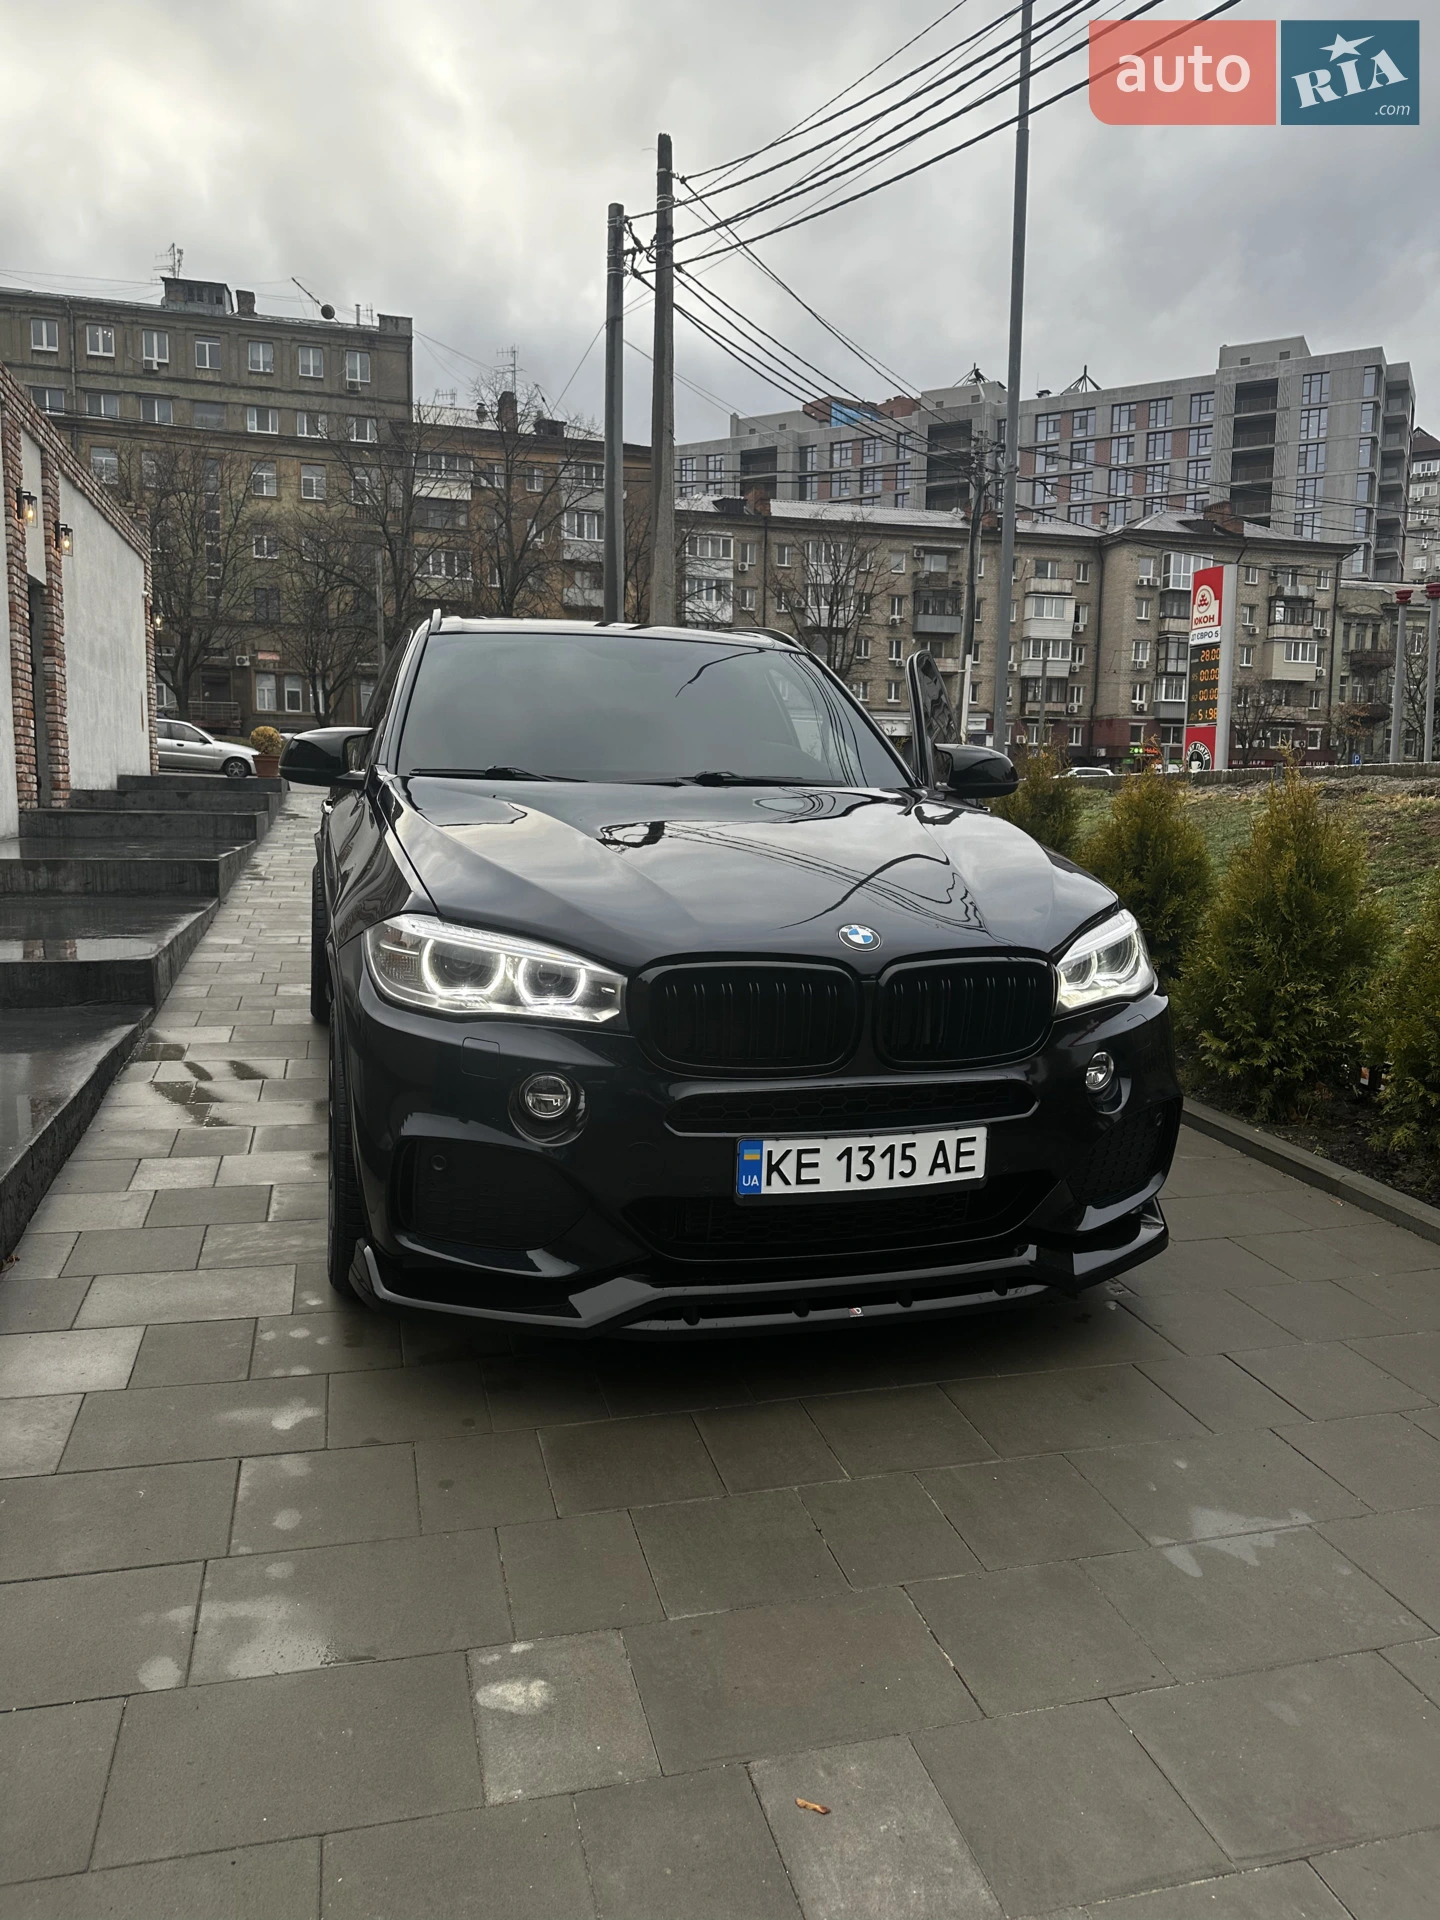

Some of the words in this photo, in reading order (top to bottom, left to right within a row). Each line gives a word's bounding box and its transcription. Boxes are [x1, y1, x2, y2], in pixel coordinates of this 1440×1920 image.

[1193, 614, 1215, 626] ЮКОН
[1214, 630, 1219, 638] 5
[1200, 647, 1220, 663] 28.00
[1199, 668, 1220, 682] 00.00
[1198, 687, 1219, 702] 00.00
[766, 1147, 821, 1187] KE
[836, 1141, 917, 1183] 1315
[928, 1135, 976, 1177] AE
[742, 1175, 759, 1187] UA
